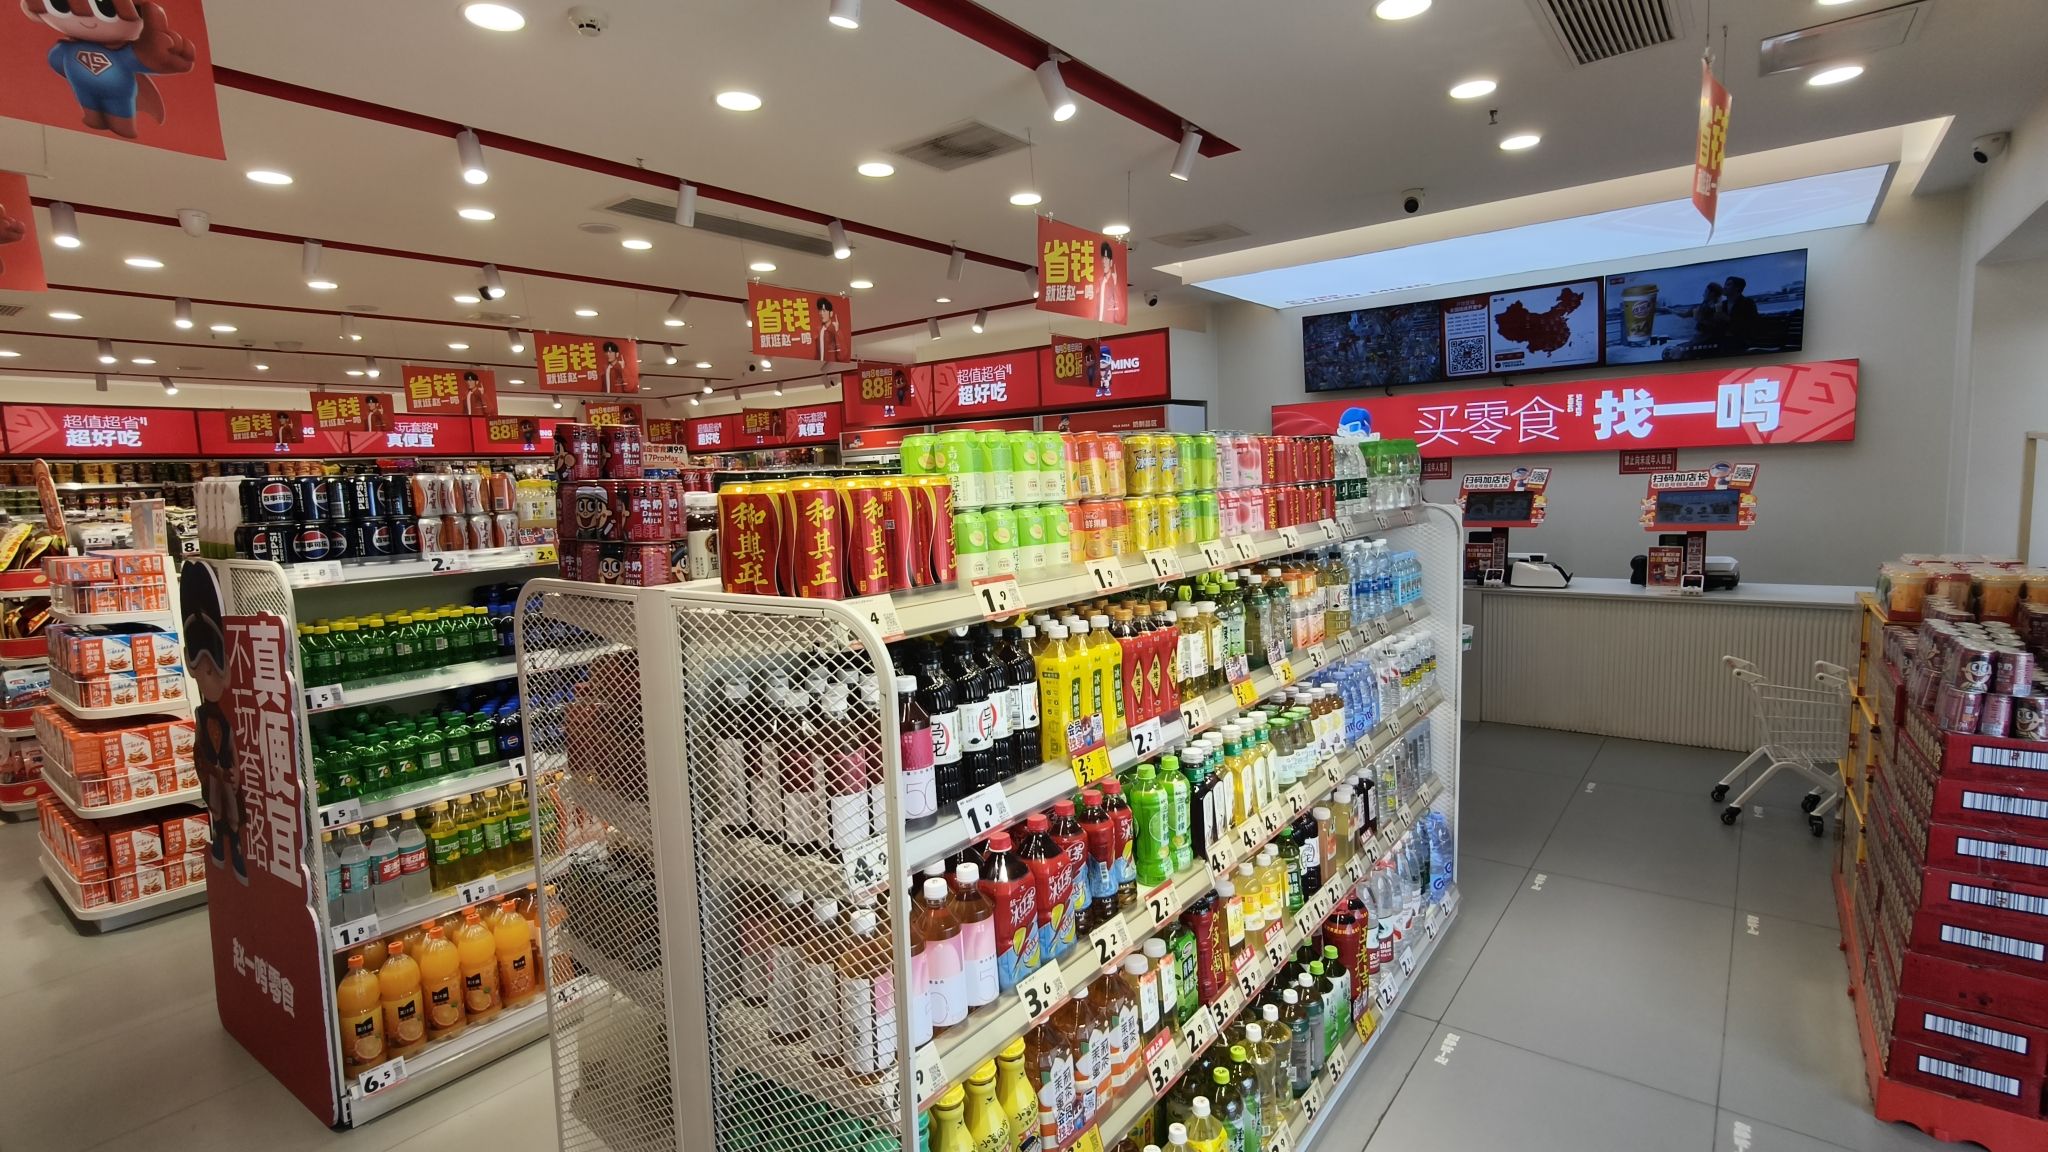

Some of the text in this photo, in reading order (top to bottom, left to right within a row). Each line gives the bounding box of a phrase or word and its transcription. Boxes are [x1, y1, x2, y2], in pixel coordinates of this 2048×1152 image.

[1044, 240, 1094, 283] 省钱
[1045, 284, 1094, 303] 就逛赵一鸣
[756, 297, 811, 334] 省钱
[760, 332, 812, 348] 就逛赵一鸣
[542, 343, 597, 373] 省钱
[1111, 357, 1140, 371] MING
[546, 369, 598, 385] 就逛赵一鸣
[957, 364, 1007, 385] 超值超省
[409, 372, 459, 399] 省钱
[958, 382, 1008, 406] 超好吃
[317, 398, 361, 420] 省钱
[1594, 377, 1781, 440] 找一鸣
[63, 414, 139, 430] 超值超省
[230, 413, 272, 434] 省钱
[798, 423, 826, 436] 真便宜
[1414, 395, 1565, 447] 买零食
[65, 430, 143, 447] 超好吃
[387, 433, 435, 448] 真便宜
[621, 442, 640, 452] 牛奶
[1465, 475, 1510, 484] 扫码加店长
[1653, 472, 1709, 483] 扫码加店长
[356, 481, 365, 510] PEPSI
[640, 499, 662, 510] 牛奶
[642, 516, 662, 524] MILK
[270, 532, 280, 562] PEPSI
[805, 498, 838, 587] 和其正
[863, 495, 888, 581] 和其正
[538, 550, 553, 560] 2.9
[1204, 547, 1219, 566] 1.9
[1151, 558, 1168, 576] 1.9
[1094, 568, 1113, 589] 1.9
[982, 588, 1007, 613] 1.9
[305, 694, 328, 709] 1.5
[1068, 720, 1082, 735] 会员
[1183, 710, 1200, 730] 2.9
[226, 624, 270, 872] 不玩套路
[249, 620, 302, 887] 真便宜
[1133, 731, 1153, 756] 2.2
[1078, 755, 1091, 770] 2.5
[1289, 794, 1303, 814] 2.5
[319, 809, 345, 827] 1.5
[967, 803, 993, 834] 1.9
[1265, 814, 1277, 832] 4.5
[1243, 829, 1257, 848] 4.5
[1212, 852, 1226, 873] 4.5
[463, 886, 484, 903] 1.8
[1011, 886, 1036, 925] 冰红茶
[1150, 896, 1169, 923] 2.2
[1313, 900, 1324, 918] 1.9
[1299, 914, 1310, 935] 1.9
[340, 927, 364, 945] 1.8
[1095, 933, 1118, 965] 2.2
[1270, 943, 1283, 968] 3.9
[1360, 924, 1370, 986] 王老吉
[232, 936, 296, 1019] 赵一鸣零食
[1242, 972, 1256, 998] 3.9
[1025, 984, 1051, 1018] 3.6
[1213, 1000, 1229, 1026] 3.4
[1187, 1024, 1203, 1054] 2.9
[364, 1070, 391, 1093] 6.5
[1152, 1058, 1170, 1093] 3.9
[1304, 1096, 1316, 1121] 3.6
